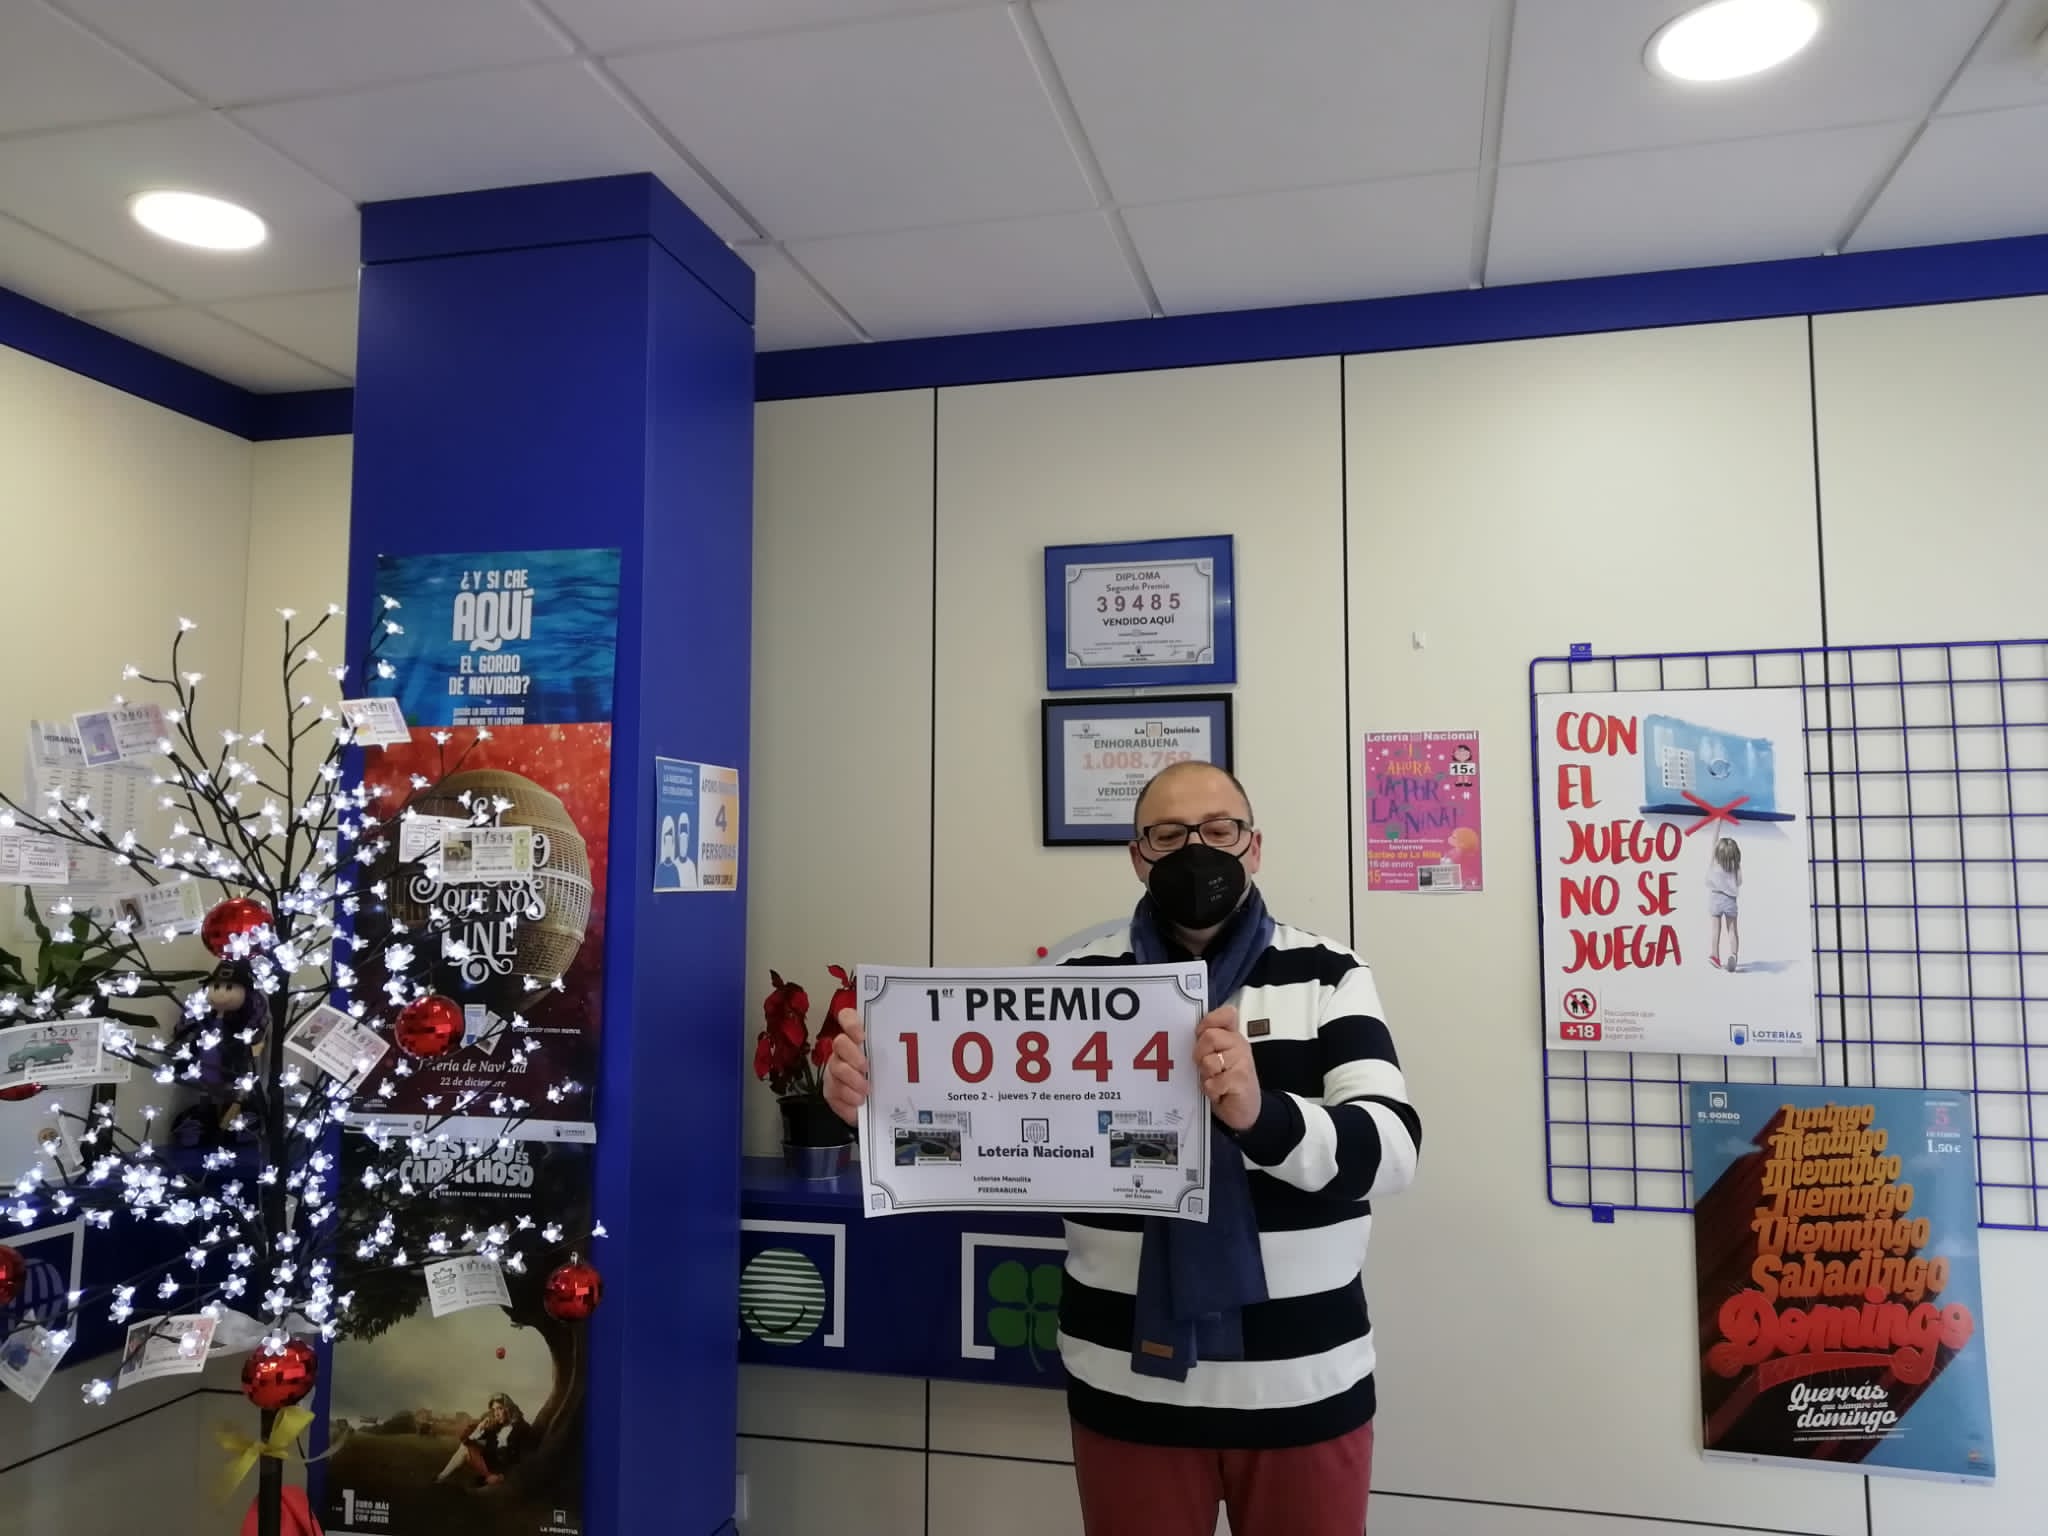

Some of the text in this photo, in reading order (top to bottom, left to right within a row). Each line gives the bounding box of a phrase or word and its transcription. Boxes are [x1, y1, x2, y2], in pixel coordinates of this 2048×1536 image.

[487, 570, 500, 589] SI
[504, 569, 528, 589] CAE
[1116, 571, 1160, 581] DIPLOMA
[1106, 582, 1170, 593] Segundo Premio
[453, 588, 534, 651] AQUÍ
[1103, 614, 1175, 626] VENDIDO AQUÍ
[460, 655, 520, 674] EL GORDO
[449, 675, 530, 695] DE NAVIDAD?
[1134, 726, 1200, 735] La Quiniela
[1423, 731, 1477, 741] Nacional
[1556, 711, 1637, 756] CON
[1094, 738, 1179, 749] ENHORABUENA
[1557, 763, 1602, 810] EL
[715, 804, 727, 832] 4
[1560, 819, 1682, 865] JUEGO
[443, 888, 489, 915] QUE
[1560, 871, 1678, 919] NO SE
[1562, 924, 1682, 973] JUEGA
[966, 987, 1140, 1021] PREMIO
[1566, 1025, 1594, 1038] +18
[1752, 1029, 1803, 1039] LOTERÍAS
[465, 1059, 476, 1073] de
[440, 1077, 451, 1086] 22
[453, 1077, 463, 1086] de
[947, 1092, 979, 1101] Sorteo
[981, 1091, 987, 1100] 2
[998, 1092, 1029, 1102] jueves
[1031, 1091, 1037, 1100] 7
[1039, 1091, 1051, 1101] de
[1053, 1093, 1082, 1101] enero
[1084, 1091, 1096, 1101] de
[1098, 1091, 1121, 1101] 2021
[1698, 1111, 1740, 1120] EL GORDO
[978, 1144, 1094, 1159] Lotería Nacional
[400, 1159, 534, 1188] CAPRICHOSO
[1002, 1174, 1032, 1183] Manolita
[1752, 1250, 1949, 1303] Sabadingo
[1708, 1287, 1975, 1384] Domingo
[1787, 1380, 1888, 1411] Querrás
[1797, 1407, 1898, 1433] domingo
[342, 1489, 355, 1525] 1
